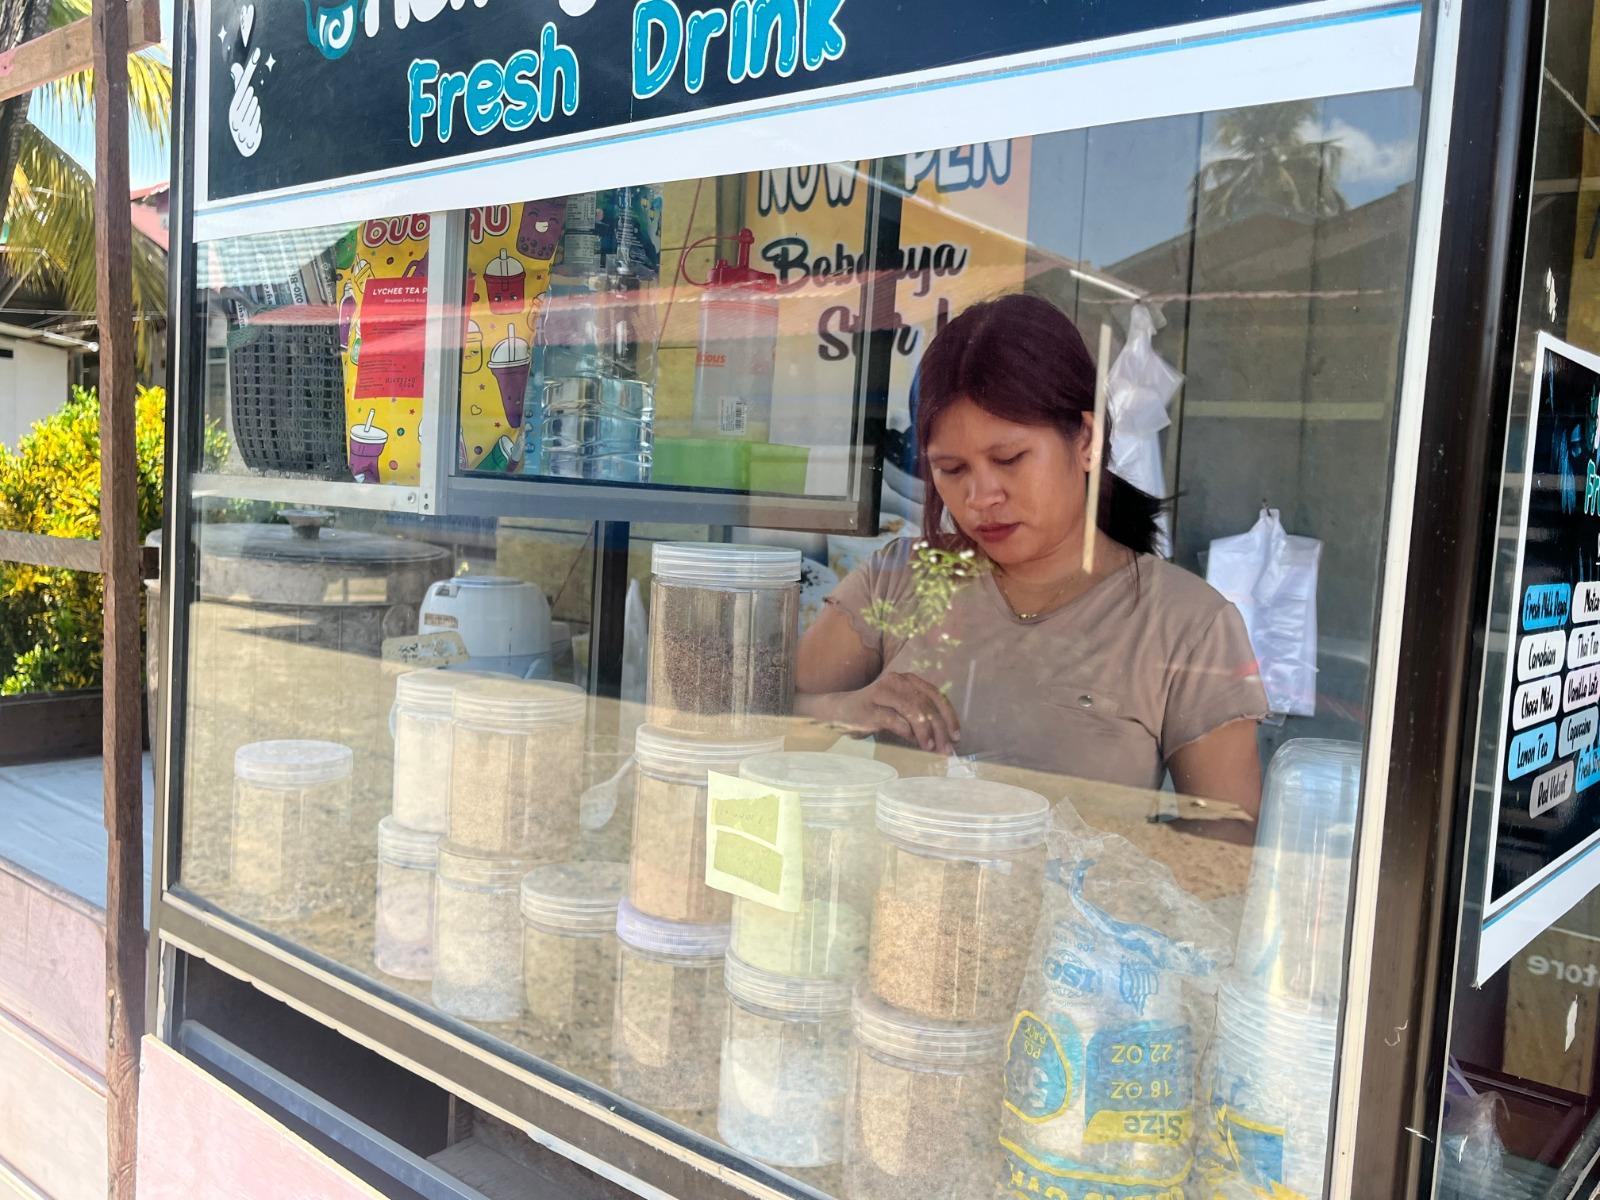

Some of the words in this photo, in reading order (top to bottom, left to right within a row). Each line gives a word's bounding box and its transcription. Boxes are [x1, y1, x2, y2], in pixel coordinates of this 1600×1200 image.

[408, 22, 579, 148] Fresh
[632, 0, 846, 99] Drink
[900, 140, 1012, 197] PEN
[372, 287, 403, 296] LYCHEE
[404, 287, 420, 295] TEA
[1521, 691, 1539, 720] Choco
[1517, 742, 1536, 769] Lemon
[1537, 733, 1549, 761] Tea
[1111, 1044, 1143, 1065] OZ
[1150, 1044, 1173, 1062] 22
[1111, 1080, 1143, 1099] OZ
[1150, 1081, 1173, 1098] 18
[1123, 1115, 1184, 1140] Size
